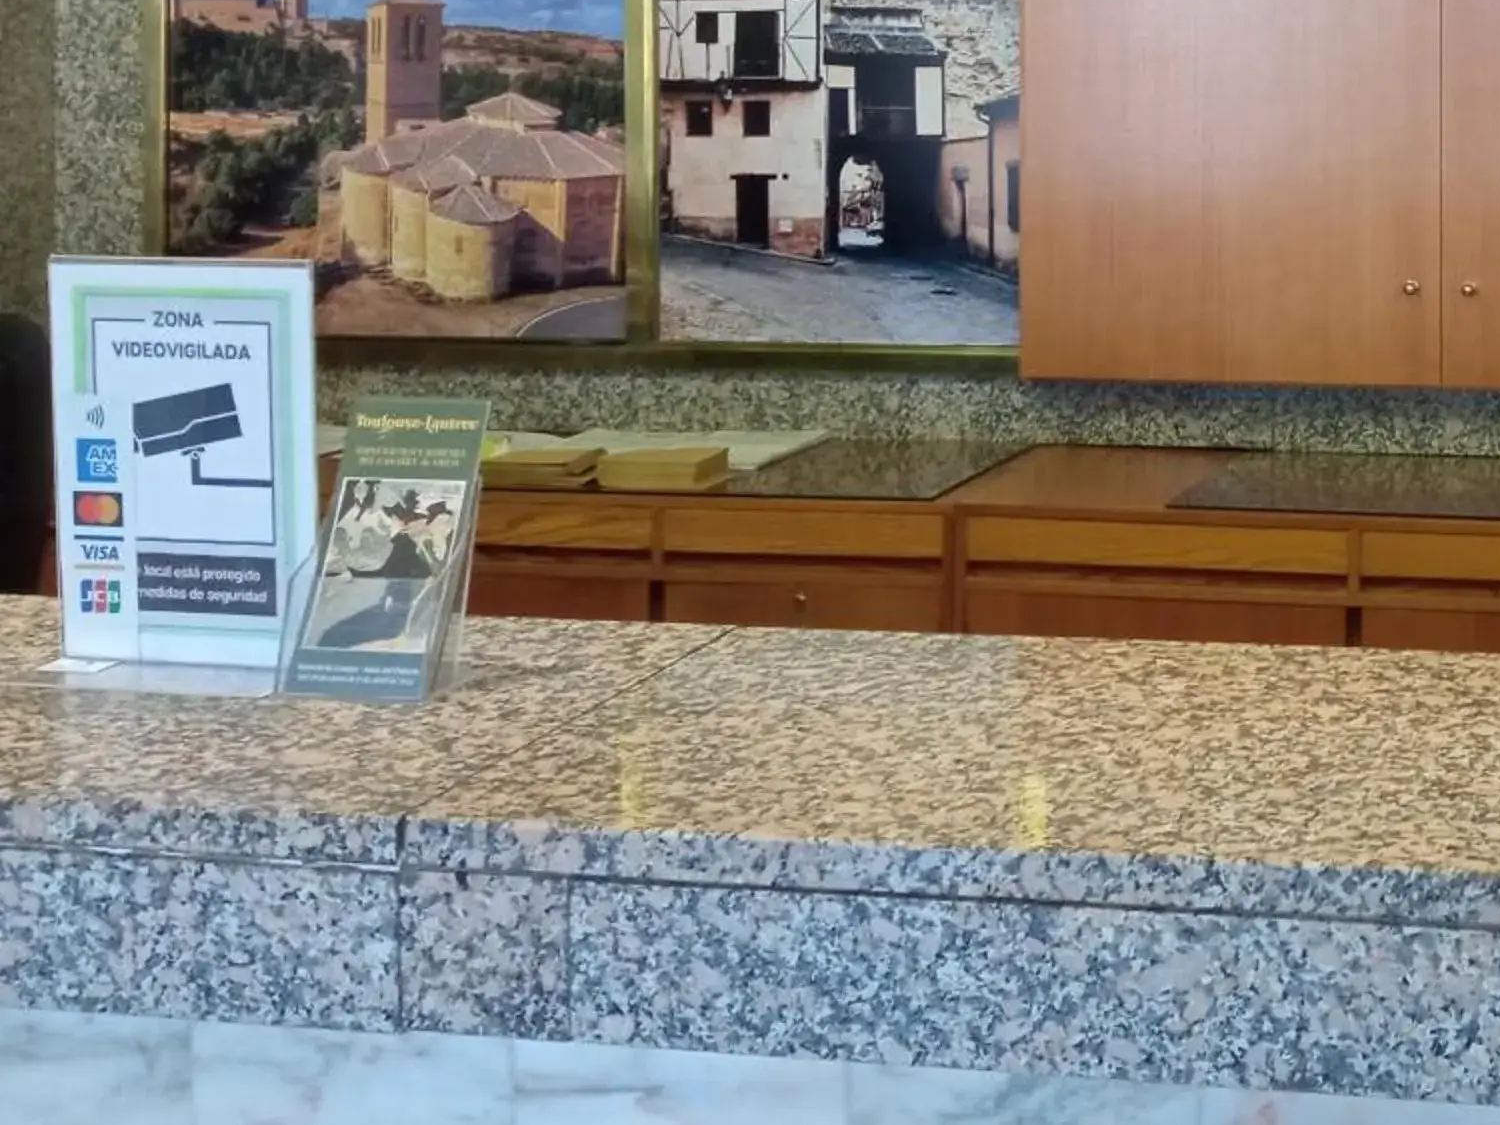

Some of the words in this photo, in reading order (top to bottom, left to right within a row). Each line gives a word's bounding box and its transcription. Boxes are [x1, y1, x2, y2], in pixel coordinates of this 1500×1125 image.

[152, 310, 204, 328] ZONA
[112, 340, 252, 361] VIDEOVIGILADA
[80, 544, 120, 562] VISA
[206, 589, 268, 604] seguridad
